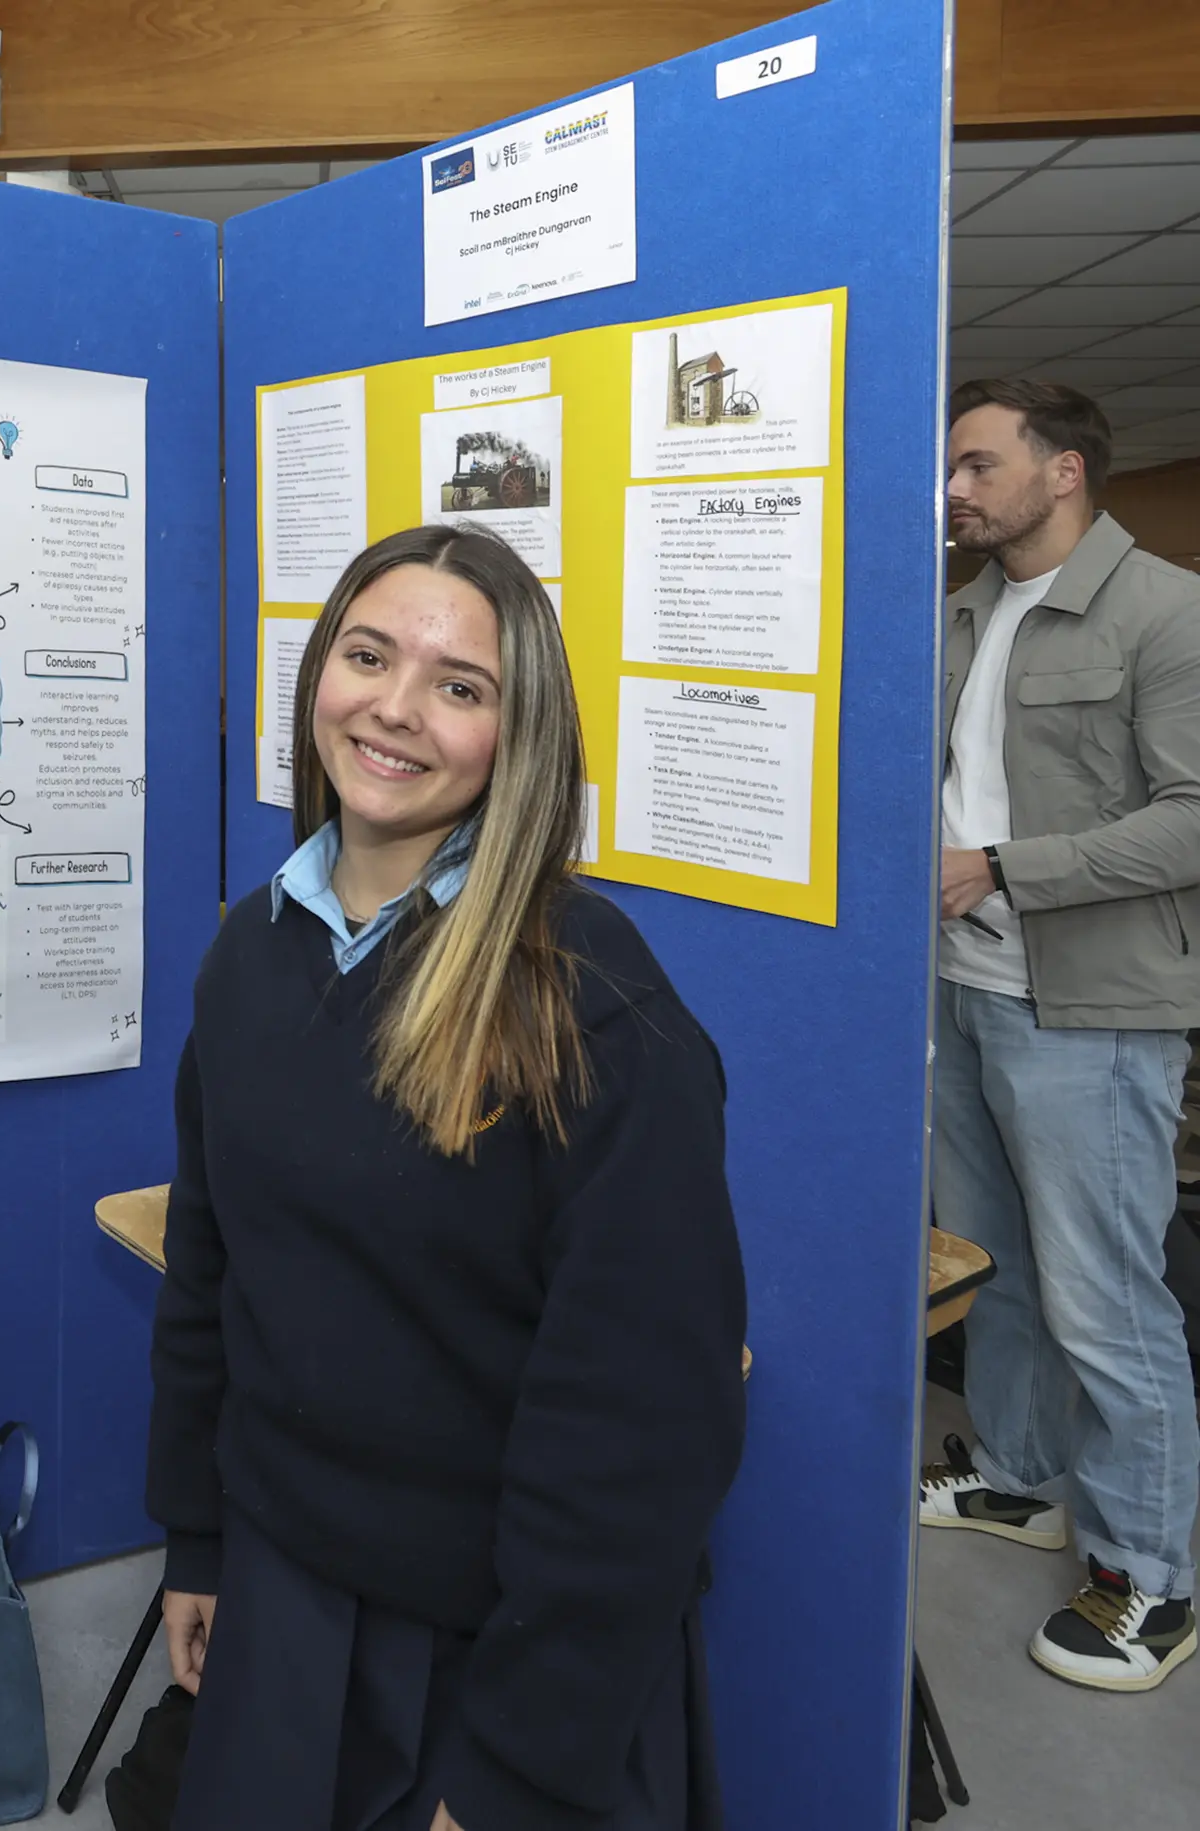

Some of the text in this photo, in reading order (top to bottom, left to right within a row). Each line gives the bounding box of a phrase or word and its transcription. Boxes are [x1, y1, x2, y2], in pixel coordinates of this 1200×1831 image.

[758, 56, 782, 79] 20
[545, 111, 608, 144] CALMAST
[503, 143, 517, 157] SE
[504, 155, 518, 168] TU
[469, 182, 578, 222] The Steam Engine
[459, 215, 591, 257] Scoil na mBraithre Dungarvan
[514, 241, 539, 252] Hickey
[464, 297, 481, 309] intel
[439, 361, 546, 383] The works of a Steam Engine
[469, 388, 479, 398] By
[490, 384, 517, 394] Hickey
[72, 473, 93, 488] Data
[45, 654, 96, 669] Conclusions
[681, 682, 760, 705] Locomotives
[38, 764, 121, 774] Education promotes
[30, 860, 108, 874] Further Research
